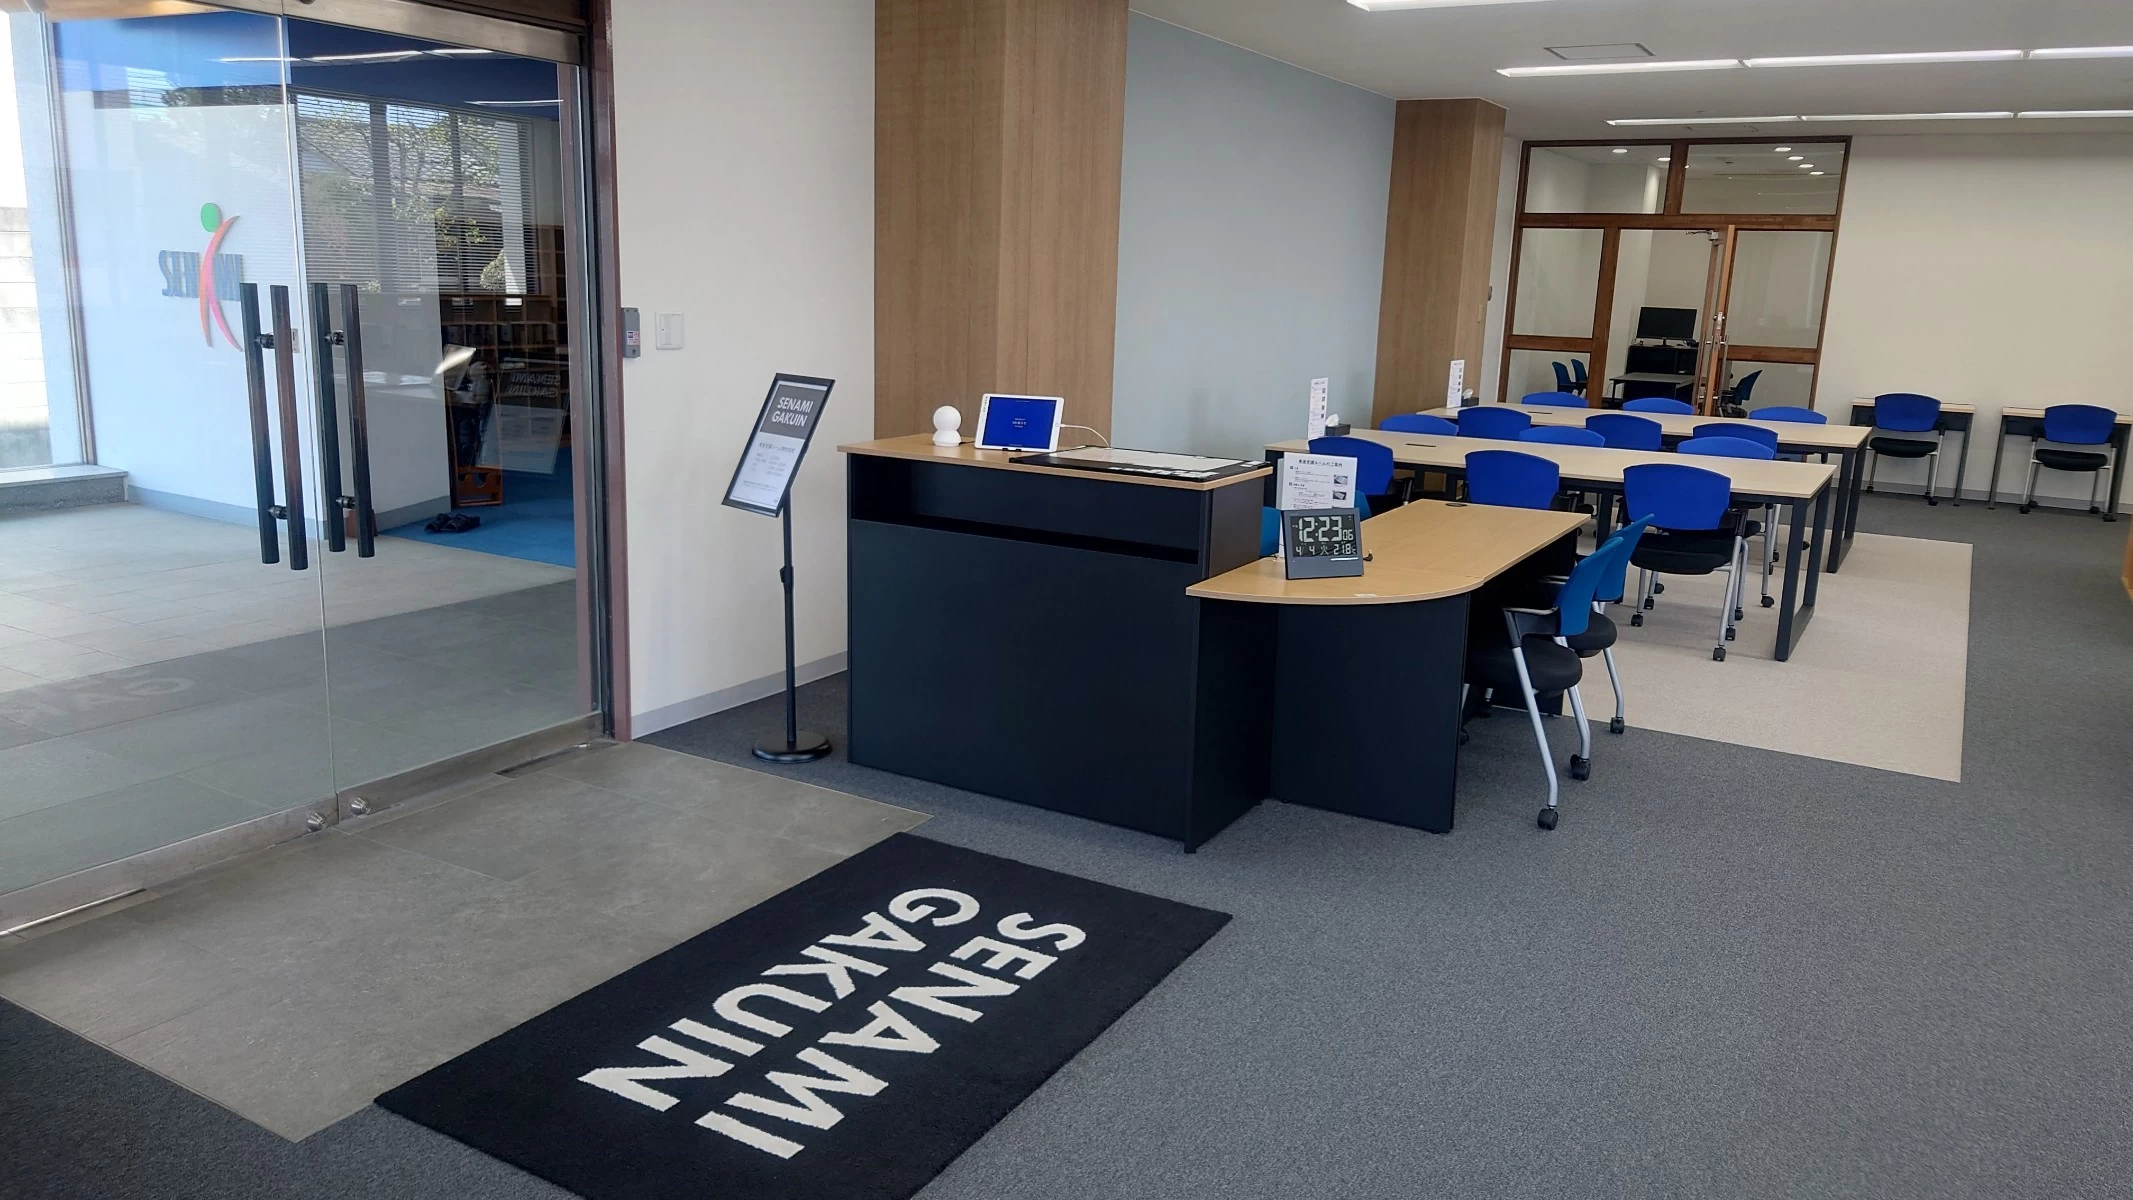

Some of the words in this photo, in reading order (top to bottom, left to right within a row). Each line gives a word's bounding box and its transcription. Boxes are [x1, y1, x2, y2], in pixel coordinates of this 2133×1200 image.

[777, 396, 814, 413] SENAMI
[771, 410, 808, 427] GAKUIN
[1299, 516, 1342, 542] 12:23
[1342, 529, 1354, 541] 06
[577, 886, 981, 1112] GAKUIN
[694, 910, 1087, 1160] SENAMI
